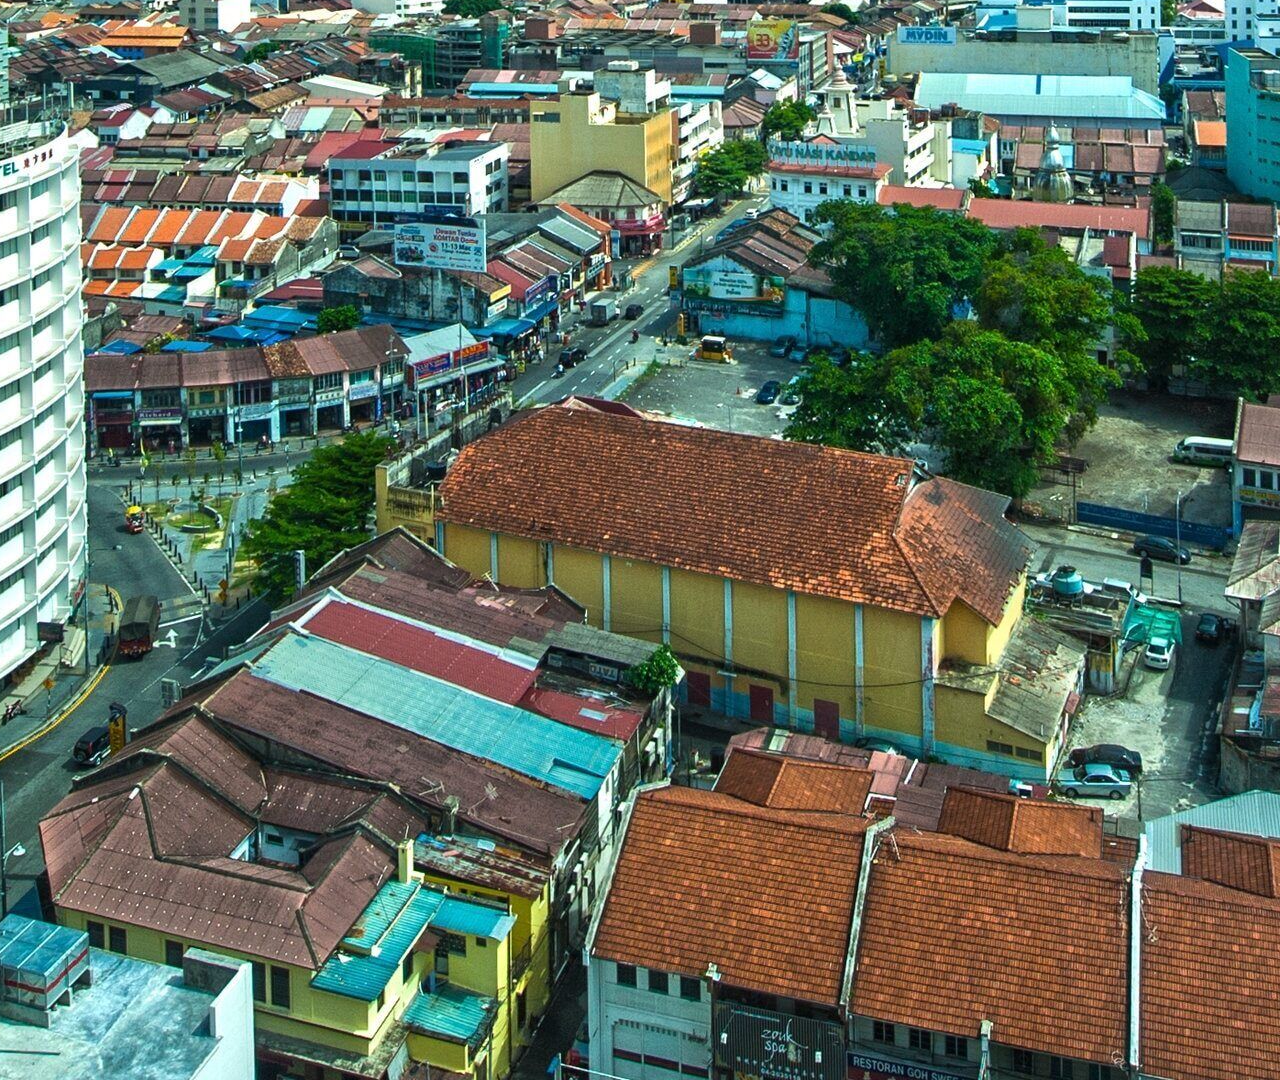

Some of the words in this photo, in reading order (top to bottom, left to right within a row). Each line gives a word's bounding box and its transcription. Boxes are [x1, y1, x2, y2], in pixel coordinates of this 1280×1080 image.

[906, 30, 948, 41] MYDIN
[796, 145, 823, 160] NASI
[826, 149, 876, 162] KANDAR
[764, 1040, 788, 1063] spa
[853, 1056, 904, 1075] RESTORAN
[907, 1067, 928, 1080] GOH
[931, 1072, 960, 1080] SW
